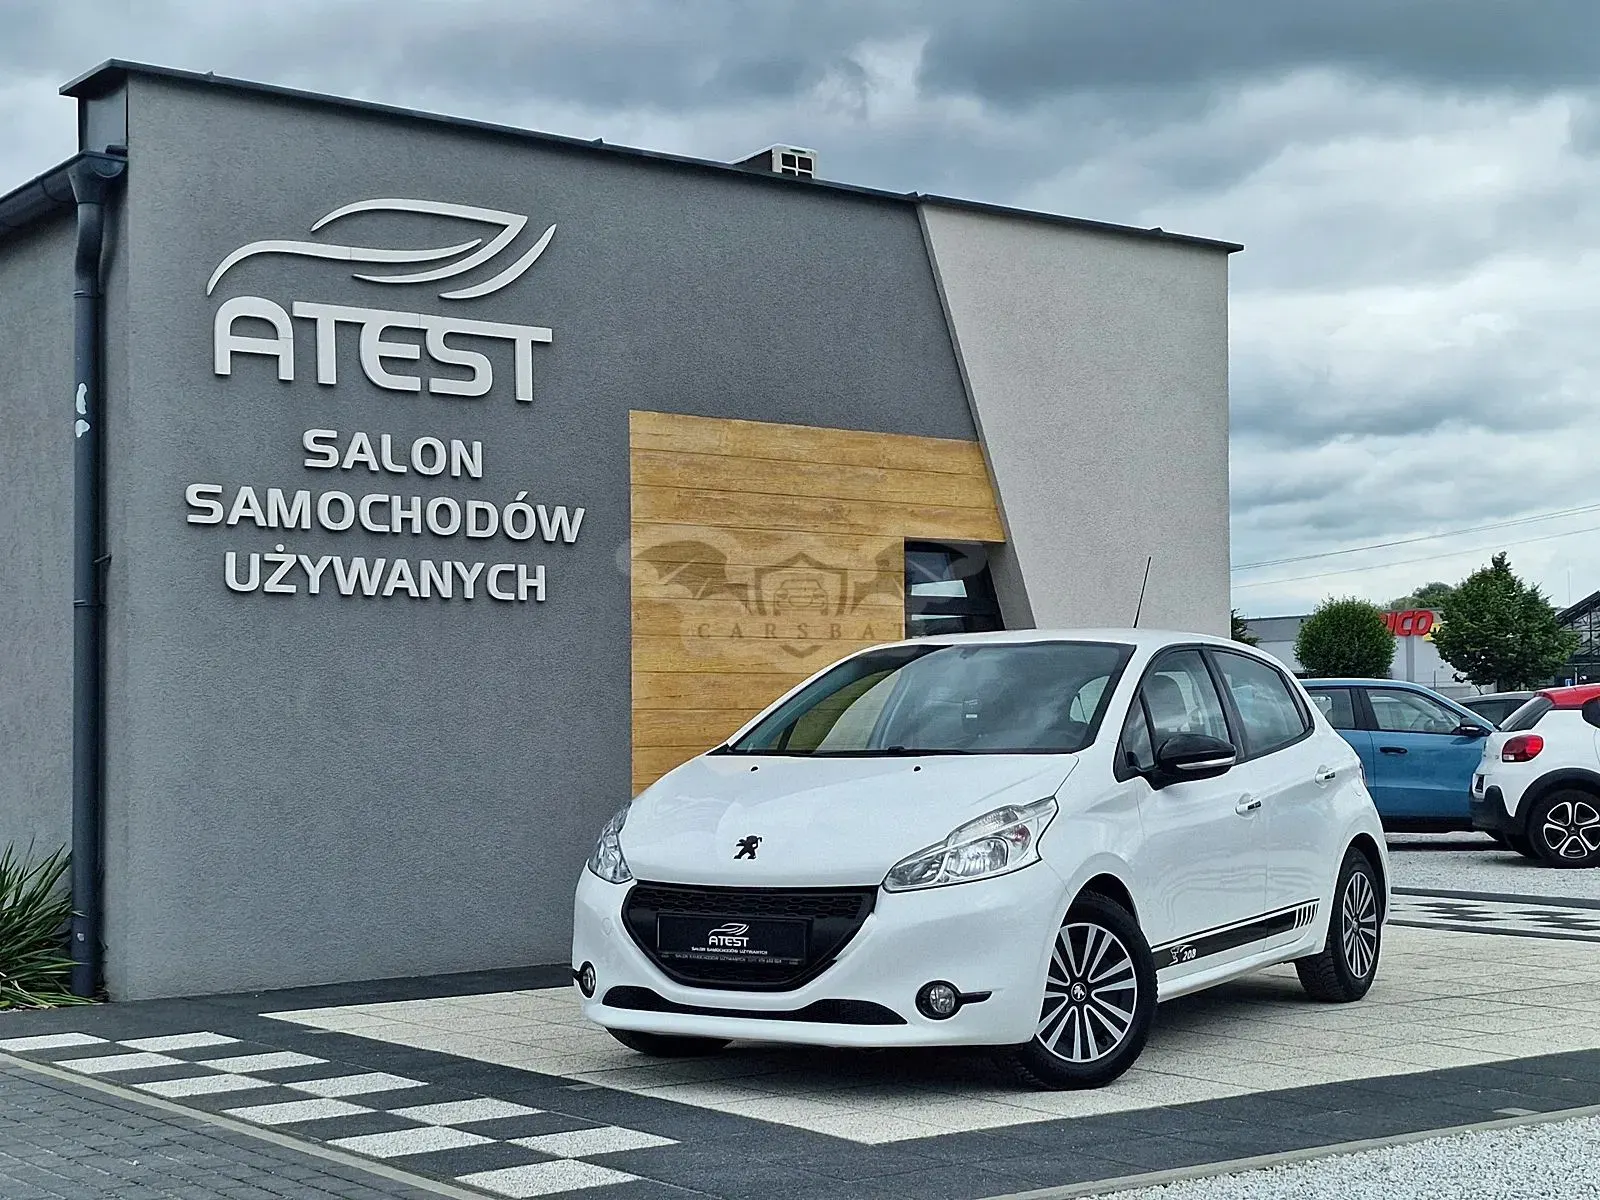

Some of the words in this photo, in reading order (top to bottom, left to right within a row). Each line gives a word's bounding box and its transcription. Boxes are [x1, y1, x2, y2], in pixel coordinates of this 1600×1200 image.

[214, 296, 552, 402] ATEST
[302, 429, 483, 478] SALON
[186, 484, 585, 543] SAMOCHODÓW
[225, 544, 546, 601] UŻYWANYCH
[708, 936, 749, 947] ATEST
[1182, 948, 1197, 961] 208
